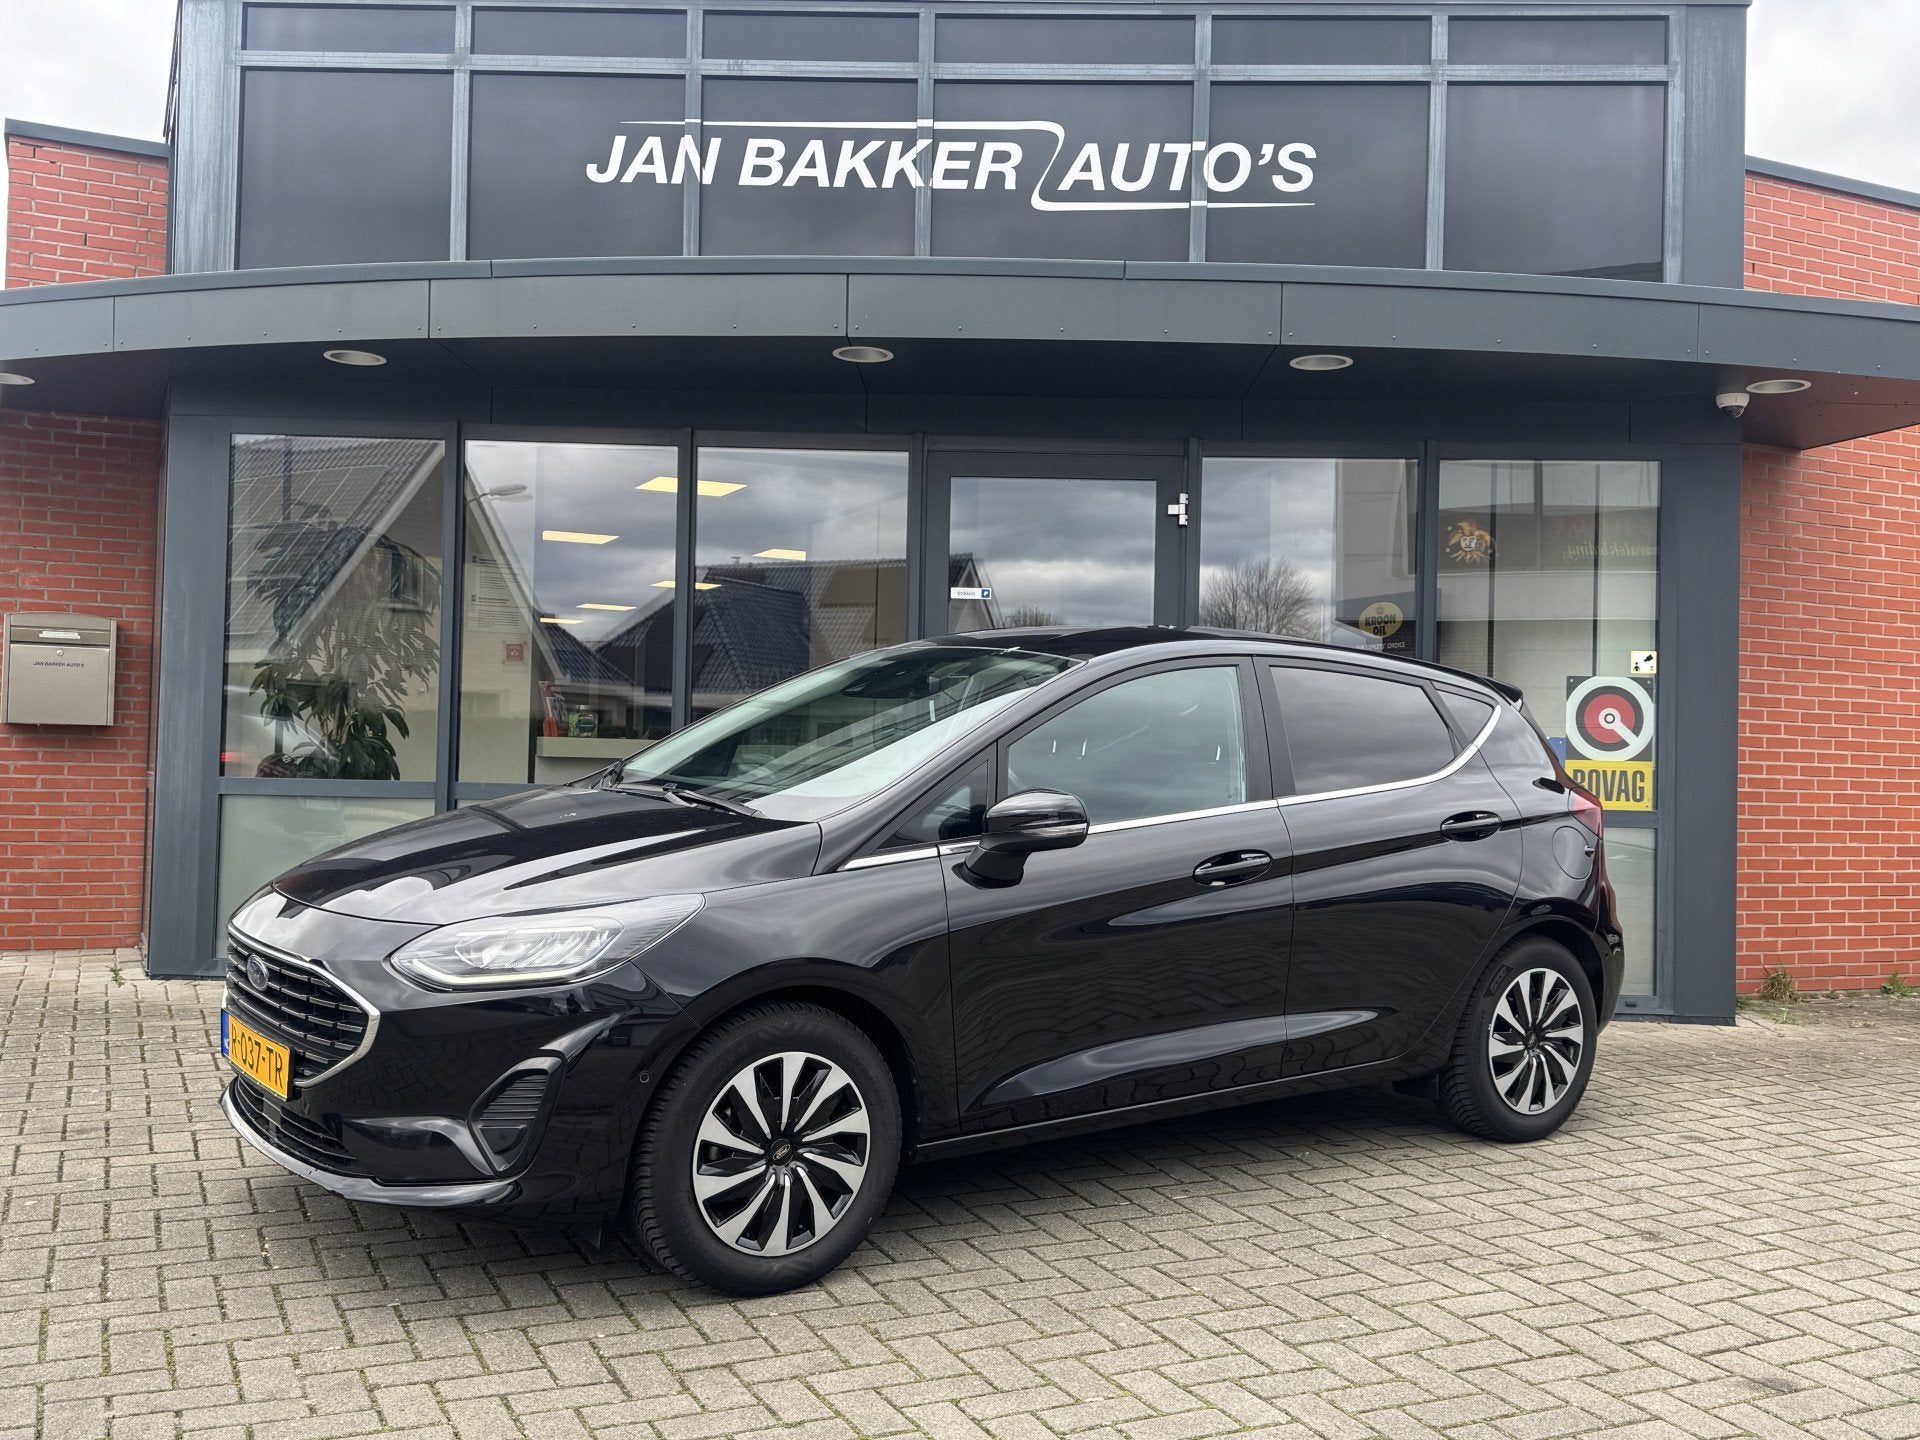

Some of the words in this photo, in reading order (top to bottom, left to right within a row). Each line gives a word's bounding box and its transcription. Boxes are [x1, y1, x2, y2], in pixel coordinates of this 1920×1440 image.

[585, 134, 722, 185] JAN
[738, 138, 1023, 190] BAKKER
[1057, 142, 1317, 193] AUTO'S
[1364, 614, 1396, 627] KROON
[1373, 625, 1387, 636] OIL
[230, 1022, 284, 1089] R-037-TR
